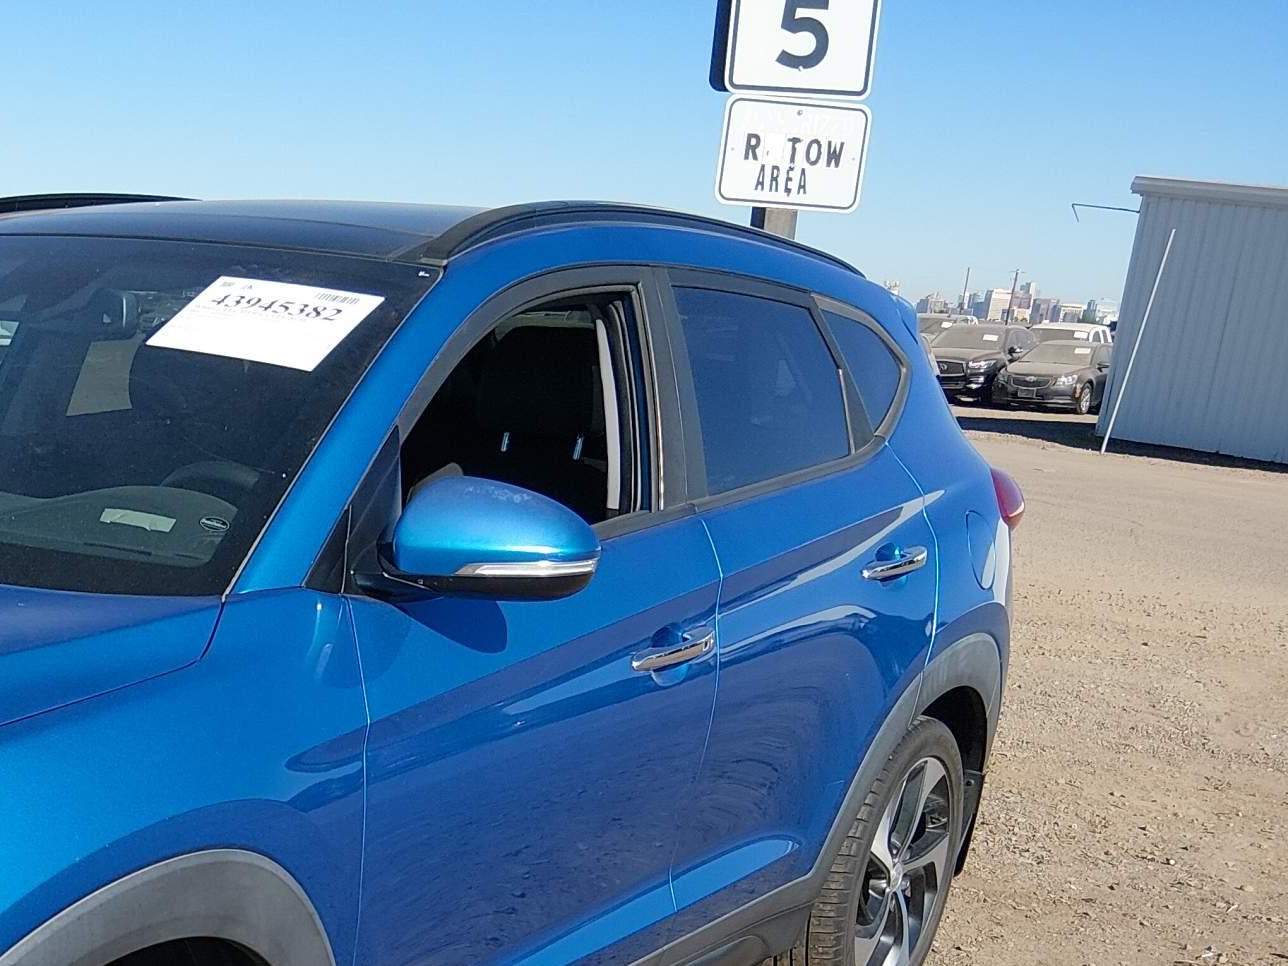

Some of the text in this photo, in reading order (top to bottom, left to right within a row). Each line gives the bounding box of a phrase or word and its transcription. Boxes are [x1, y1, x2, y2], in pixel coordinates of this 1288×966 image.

[775, 0, 830, 70] 5
[787, 137, 845, 168] TOW
[754, 163, 808, 196] AREA
[211, 293, 344, 322] 43945382
